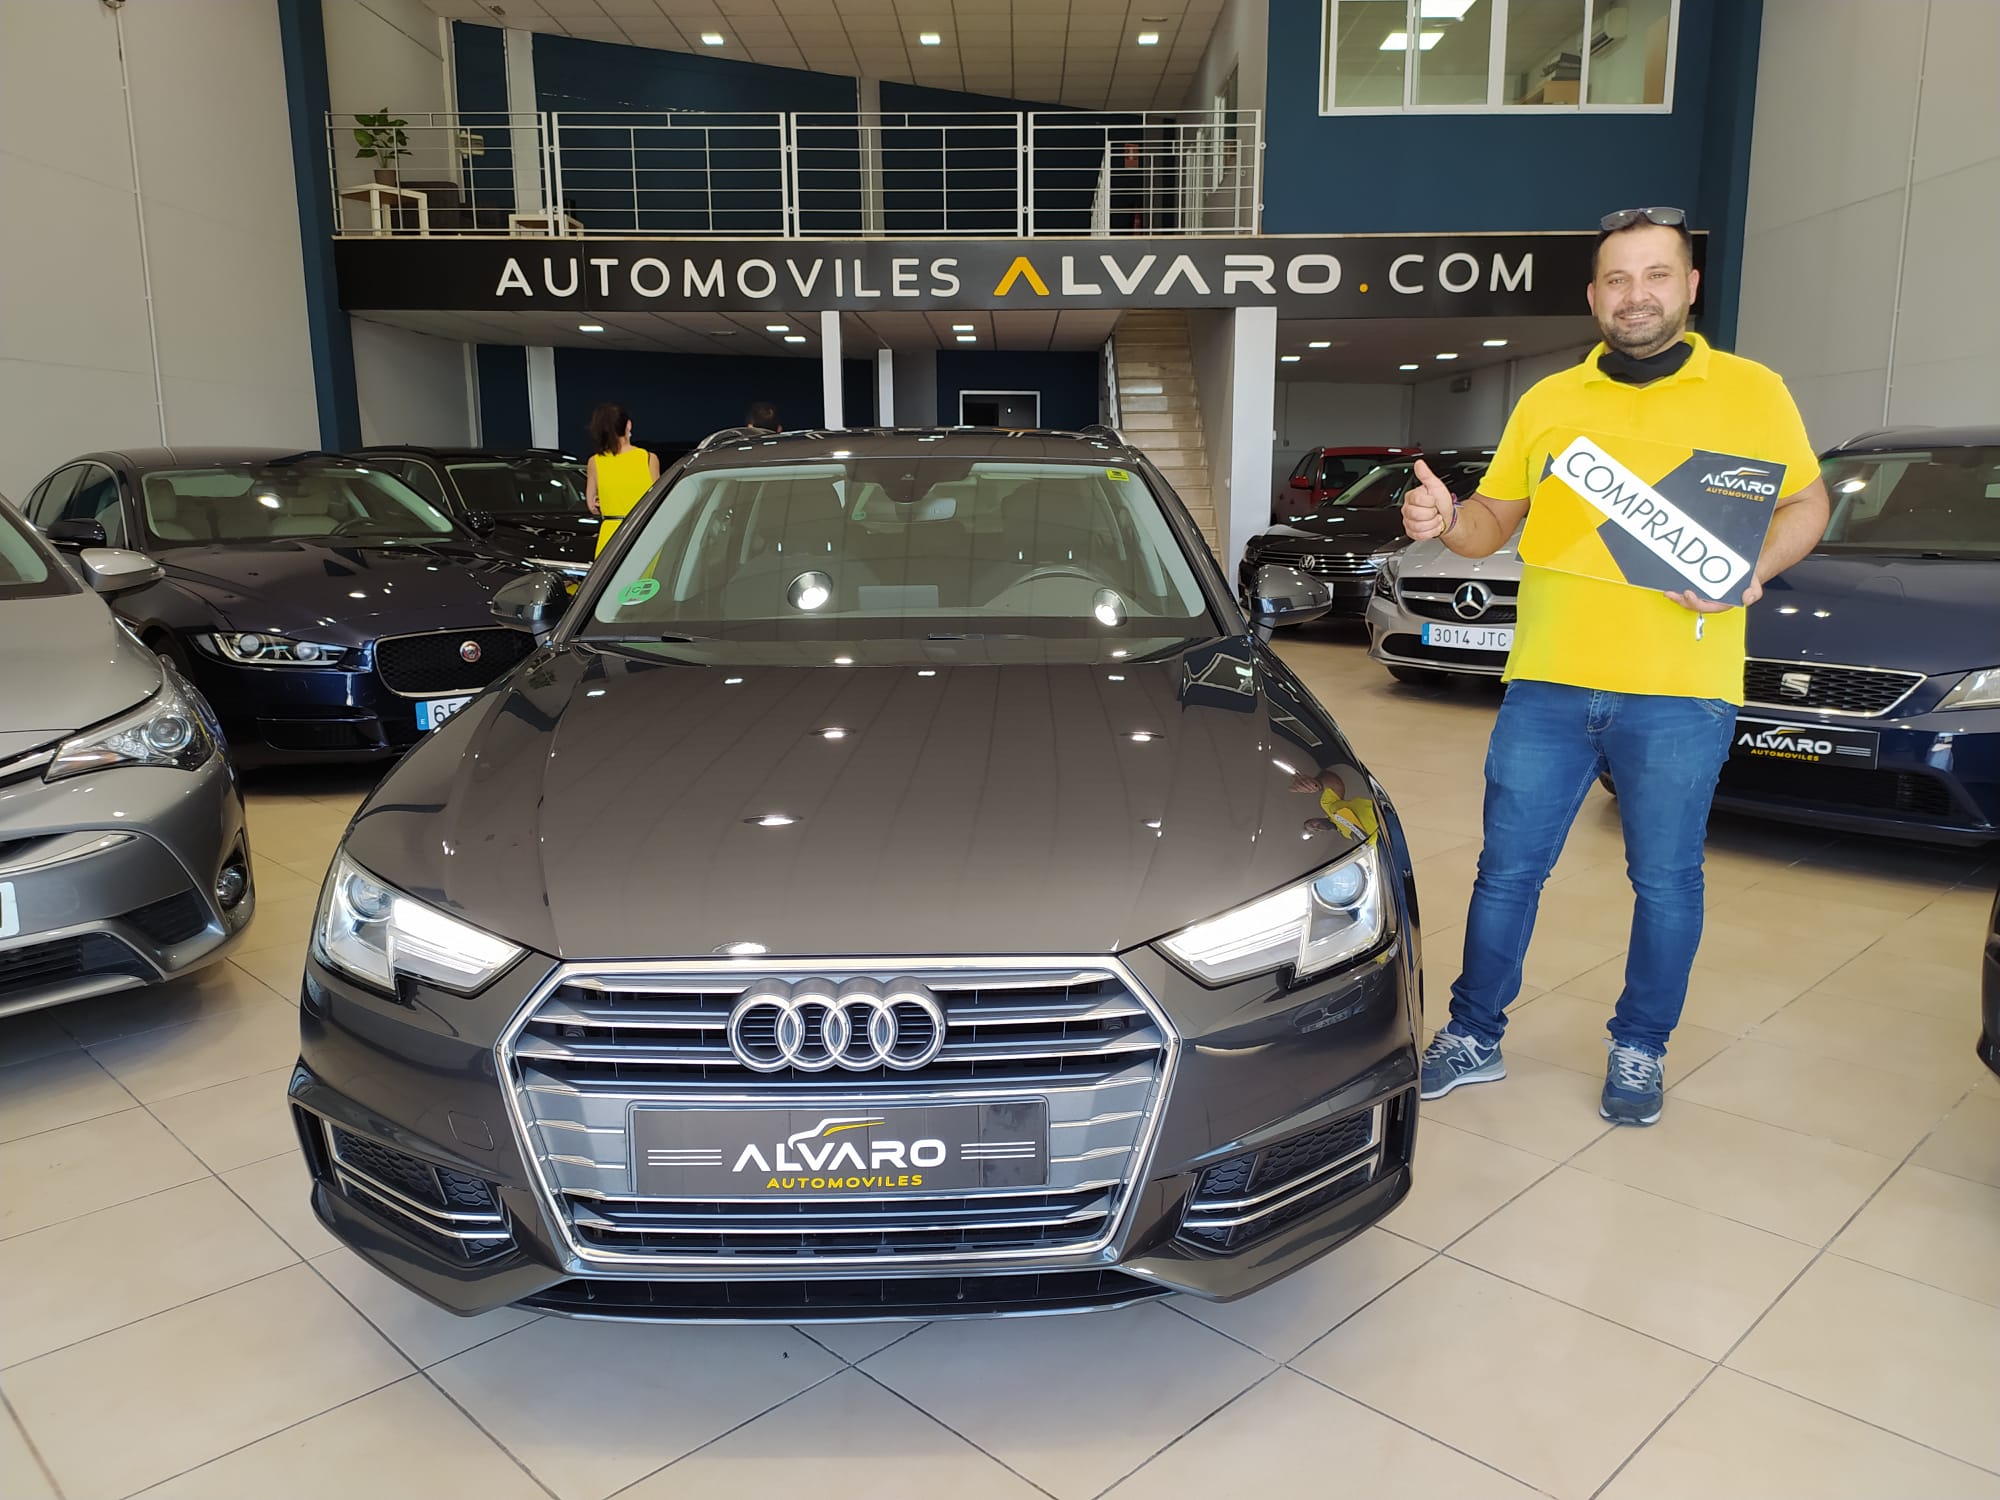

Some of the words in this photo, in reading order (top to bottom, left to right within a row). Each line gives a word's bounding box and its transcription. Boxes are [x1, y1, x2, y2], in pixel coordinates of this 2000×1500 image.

[495, 256, 961, 298] AUTOMOVILES
[1700, 472, 1776, 496] ALVARO
[1705, 485, 1765, 502] AUTOMOVILES
[1566, 451, 1732, 584] COMPRADO
[1434, 628, 1470, 645] 3014
[1477, 631, 1507, 647] JTC
[1737, 732, 1832, 755] ALVARO
[1750, 748, 1820, 762] AUTOMOVILES
[732, 1138, 946, 1172] ALVARO
[766, 1174, 923, 1189] AUTOMOVILES
